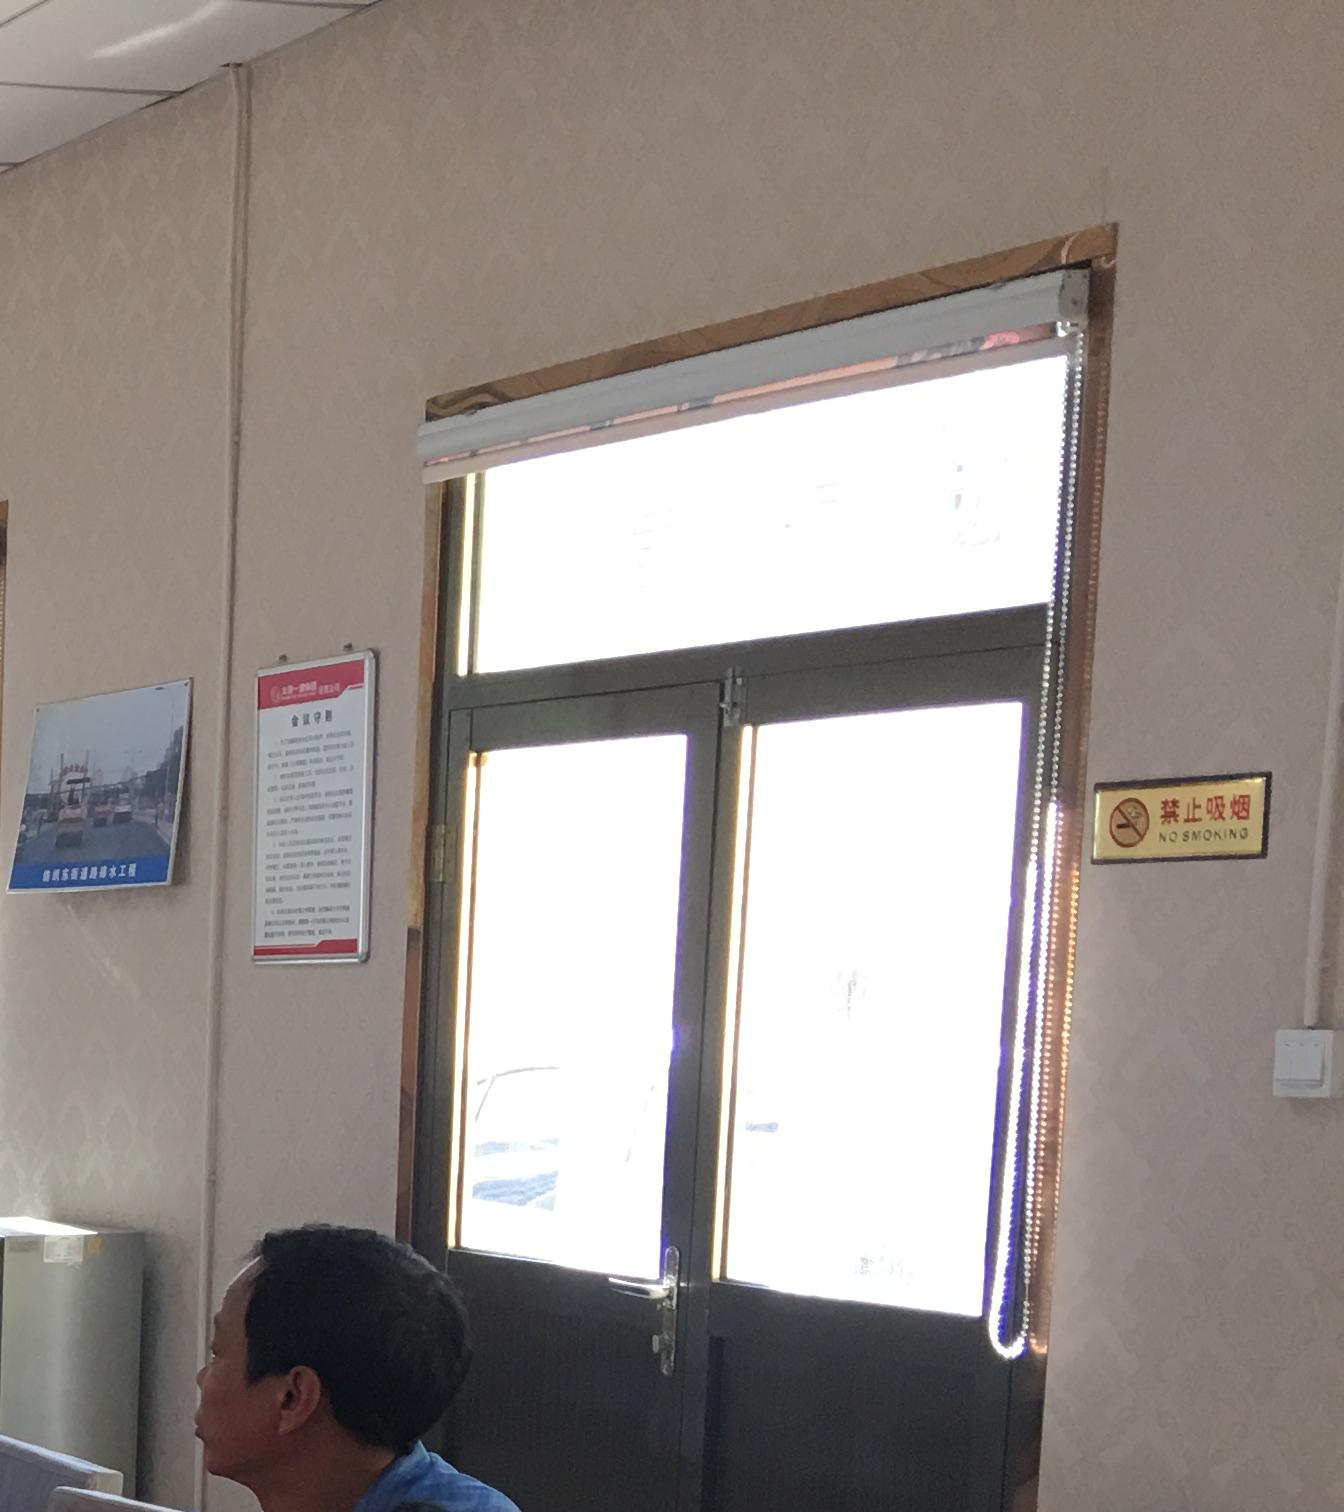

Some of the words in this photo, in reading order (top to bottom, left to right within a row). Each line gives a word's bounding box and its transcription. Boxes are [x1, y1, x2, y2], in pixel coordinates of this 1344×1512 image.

[1160, 794, 1251, 825] 禁止吸烟
[1159, 831, 1178, 843] NO
[1181, 827, 1250, 842] SMOKING
